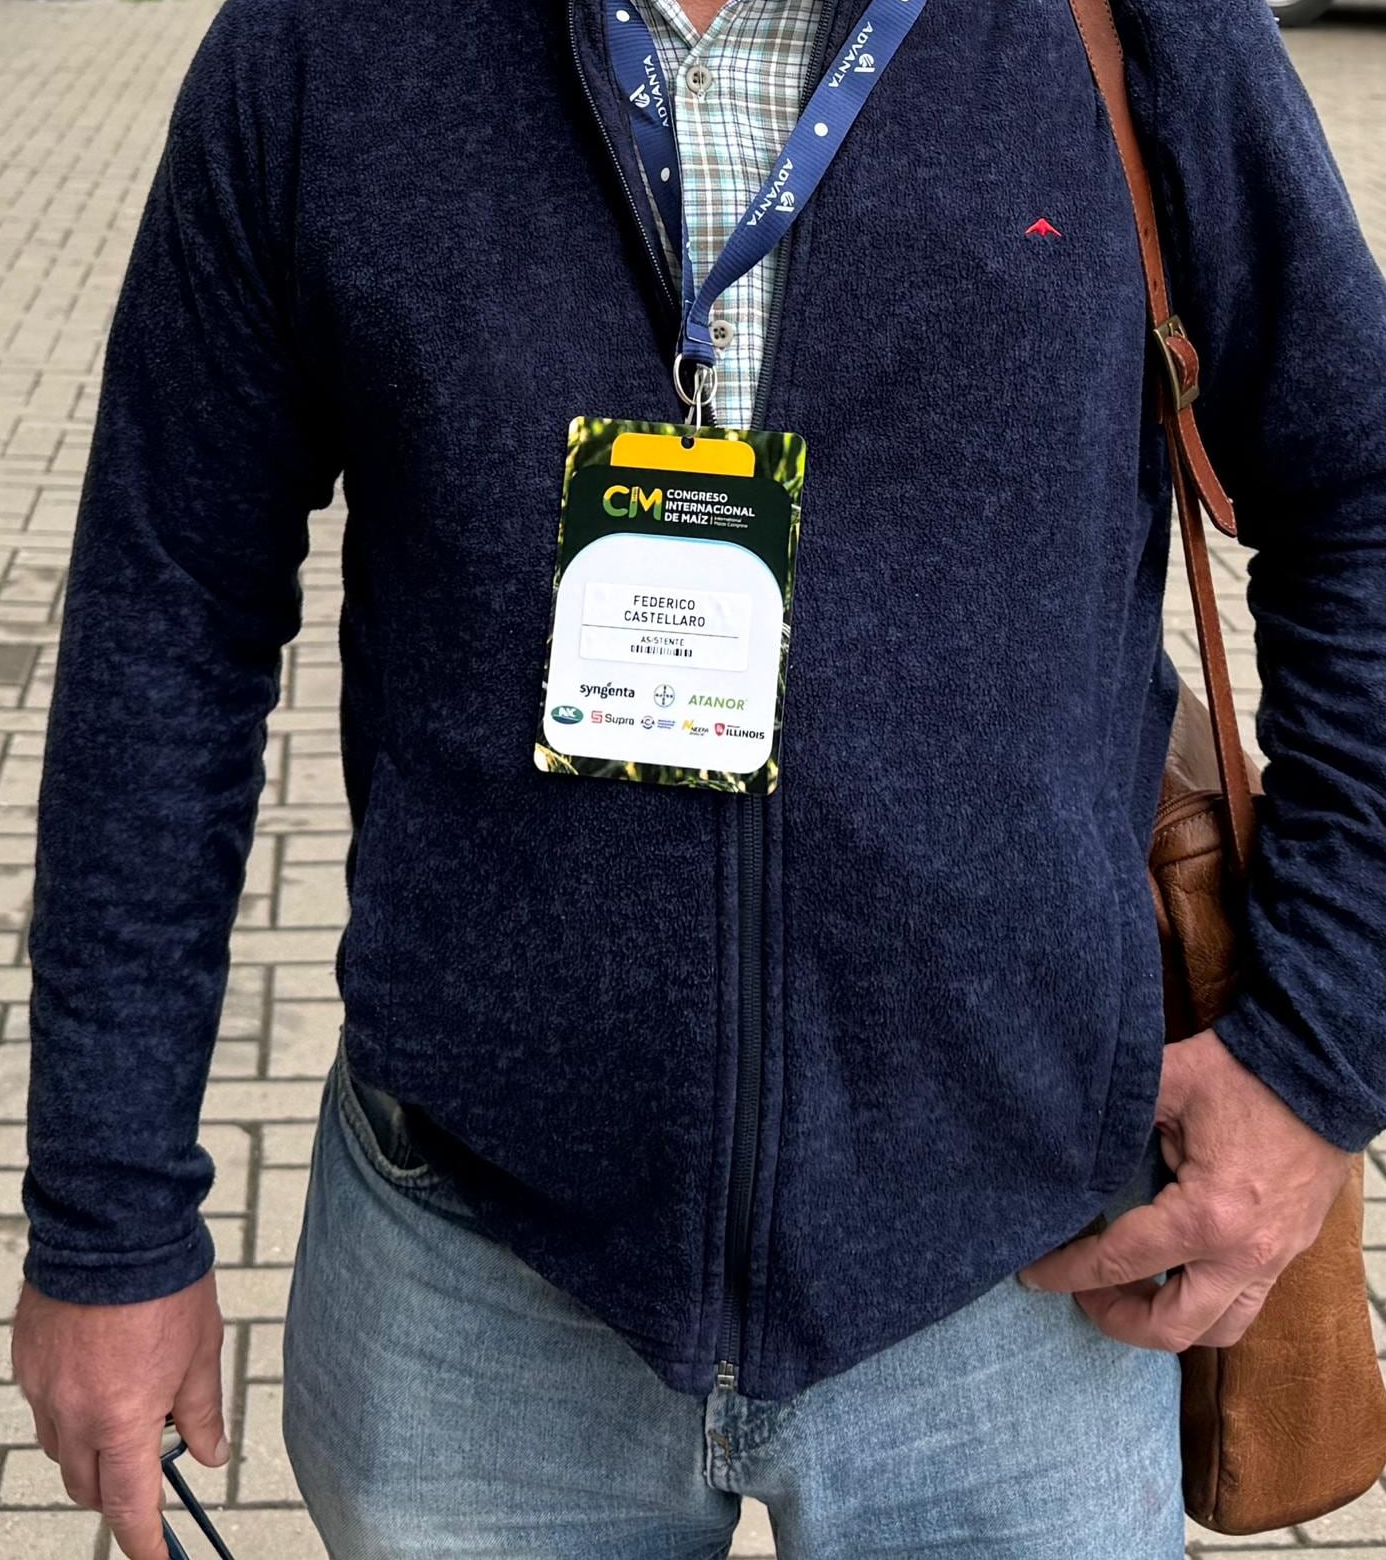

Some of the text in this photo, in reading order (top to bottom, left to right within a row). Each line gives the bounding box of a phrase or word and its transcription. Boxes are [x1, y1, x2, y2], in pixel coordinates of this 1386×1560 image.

[827, 21, 874, 88] ADVANTA
[642, 54, 670, 128] ADVANTA
[746, 158, 794, 227] ADVANTA
[666, 489, 729, 503] CONGRESO
[665, 500, 756, 517] INTERNACIONAL
[664, 512, 680, 523] DE
[681, 513, 709, 525] MAÍZ
[633, 595, 696, 611] FEDERICO
[624, 610, 706, 628] CASTELLARO
[640, 635, 685, 647] ASISTENTE
[579, 682, 636, 700] syngenta
[688, 694, 746, 711] ATANOR
[725, 728, 765, 740] ILLINOIS
